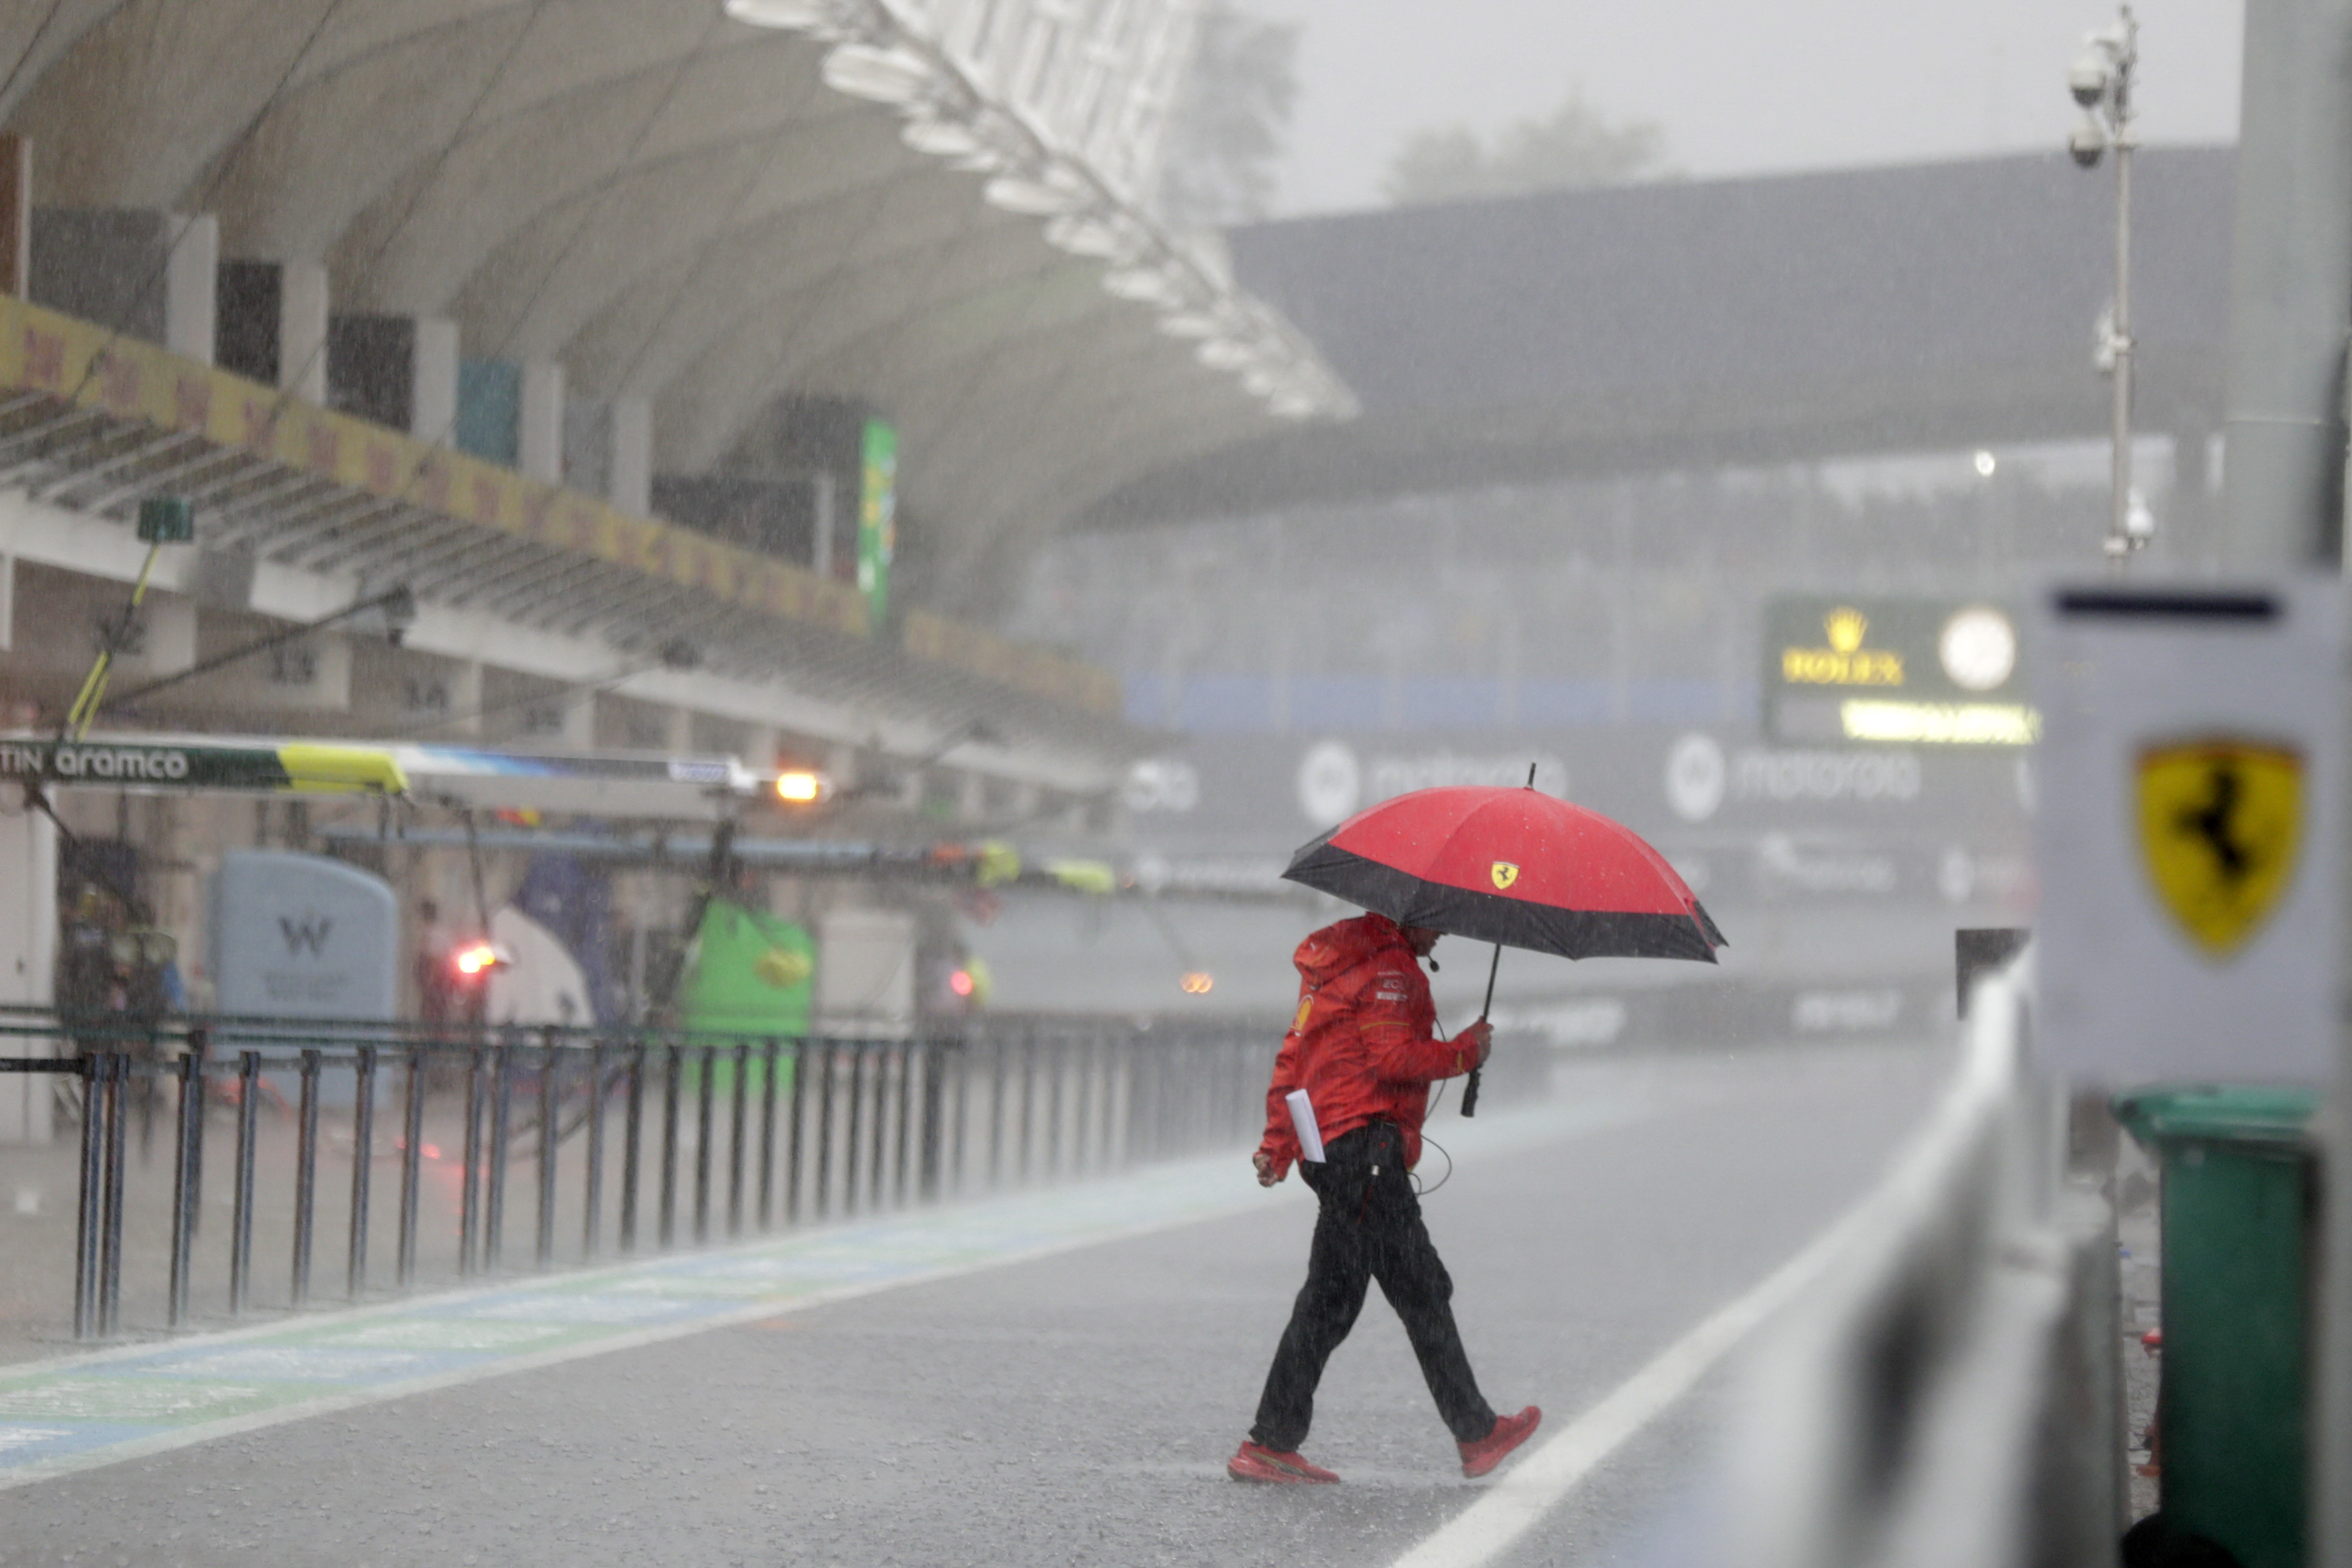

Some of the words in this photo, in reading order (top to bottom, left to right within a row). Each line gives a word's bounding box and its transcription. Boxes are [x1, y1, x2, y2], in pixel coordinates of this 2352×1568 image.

[1783, 646, 1903, 686] ROLEX
[55, 748, 189, 780] aramco
[1737, 750, 1921, 800] motorola
